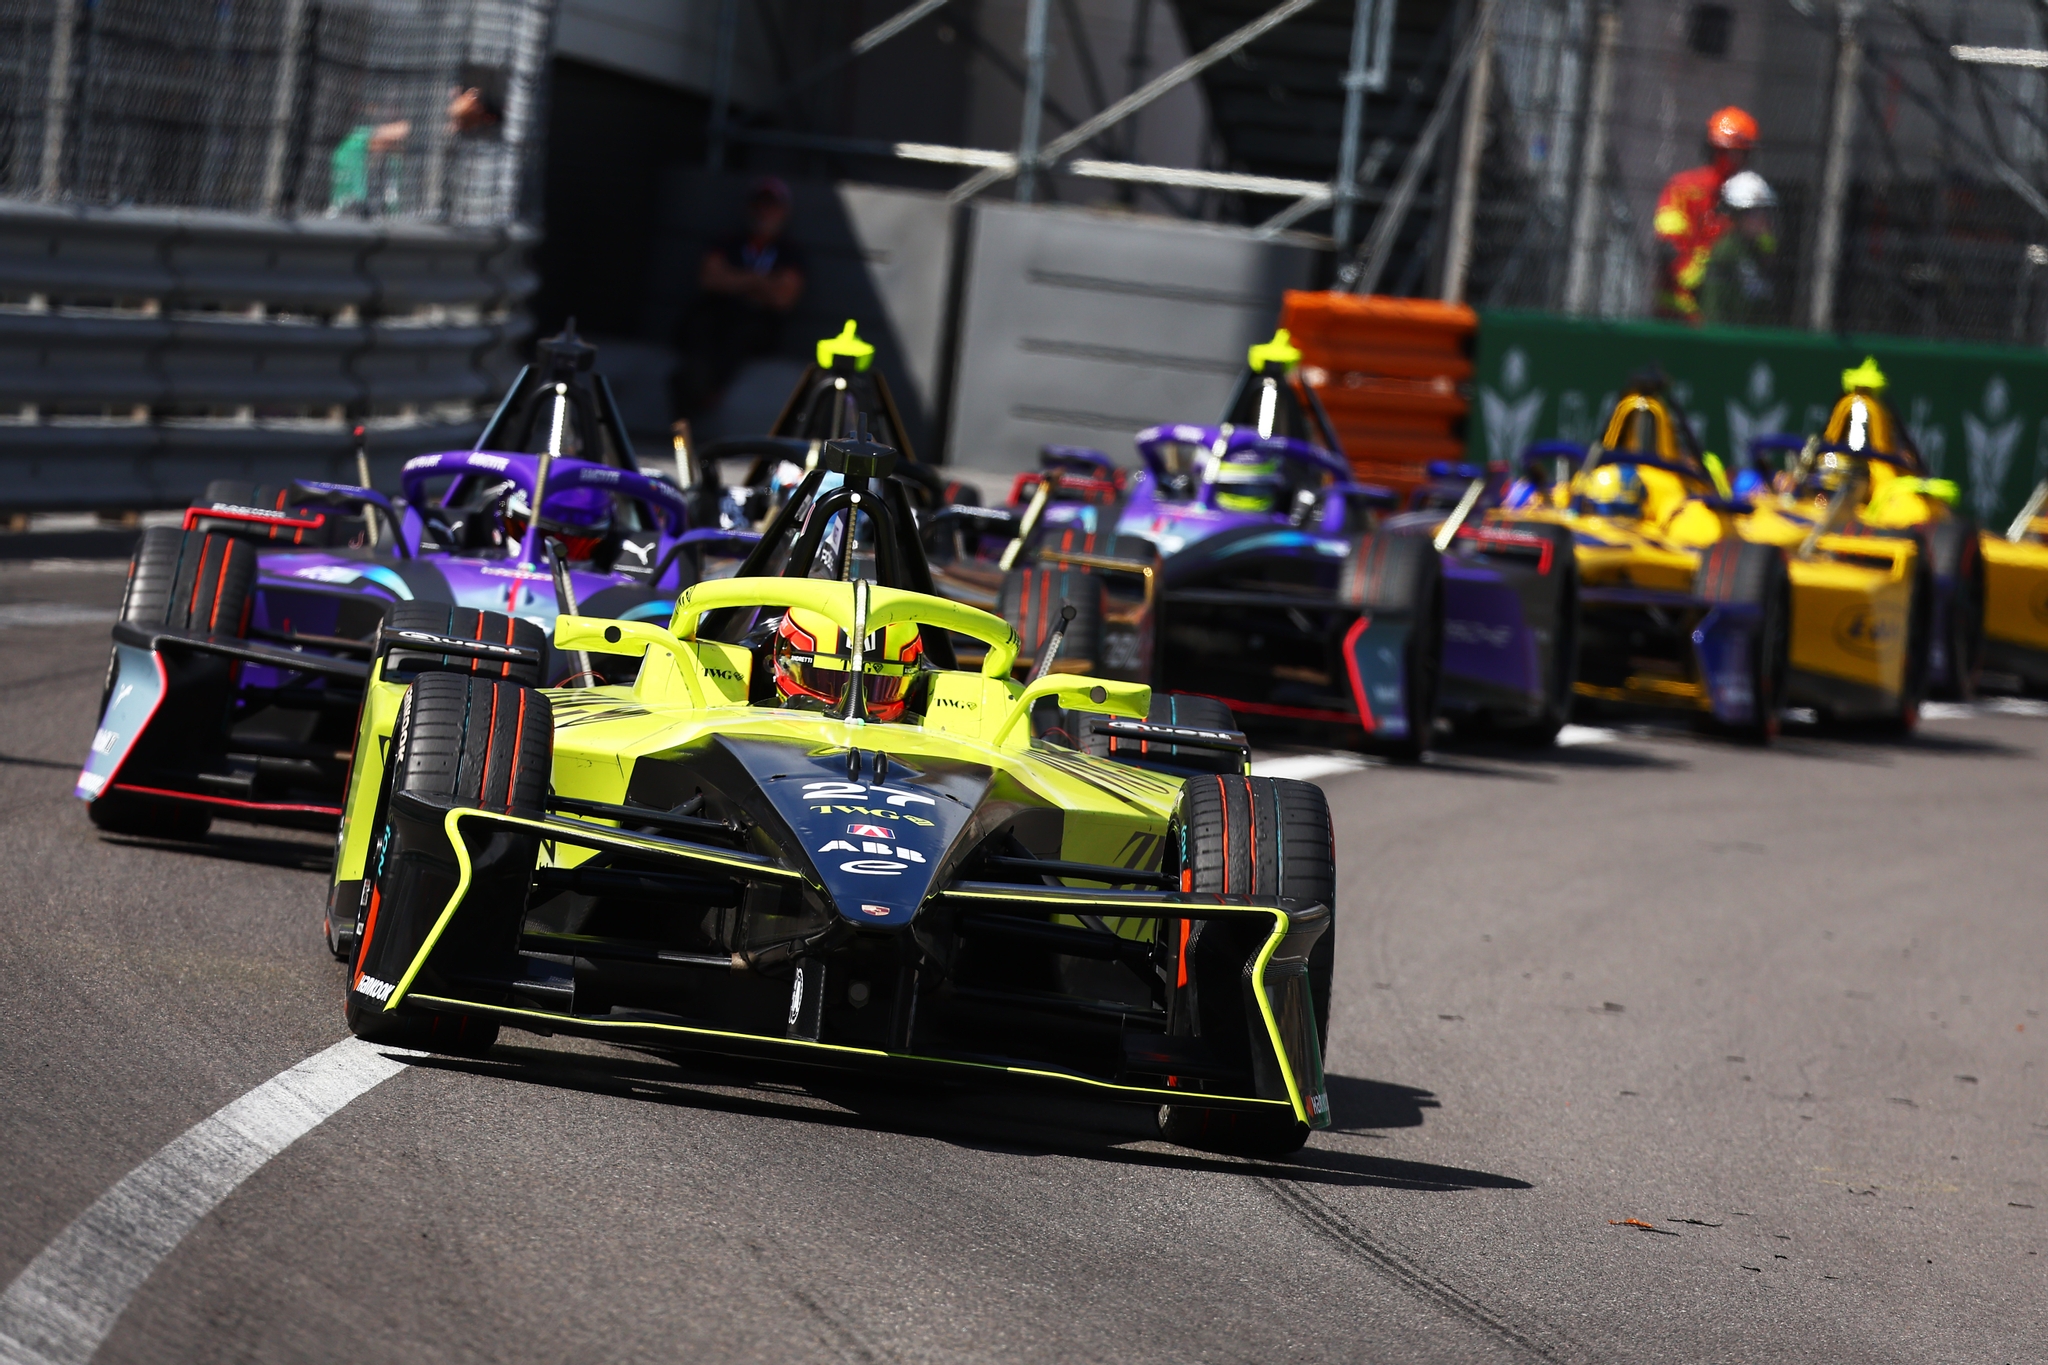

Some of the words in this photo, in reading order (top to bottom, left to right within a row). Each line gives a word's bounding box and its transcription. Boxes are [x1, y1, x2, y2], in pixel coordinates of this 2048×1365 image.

[701, 667, 732, 680] TWG
[839, 658, 874, 674] TG
[933, 697, 967, 710] TWG
[801, 781, 936, 807] 27
[809, 805, 900, 820] TWG
[817, 839, 927, 864] ABB
